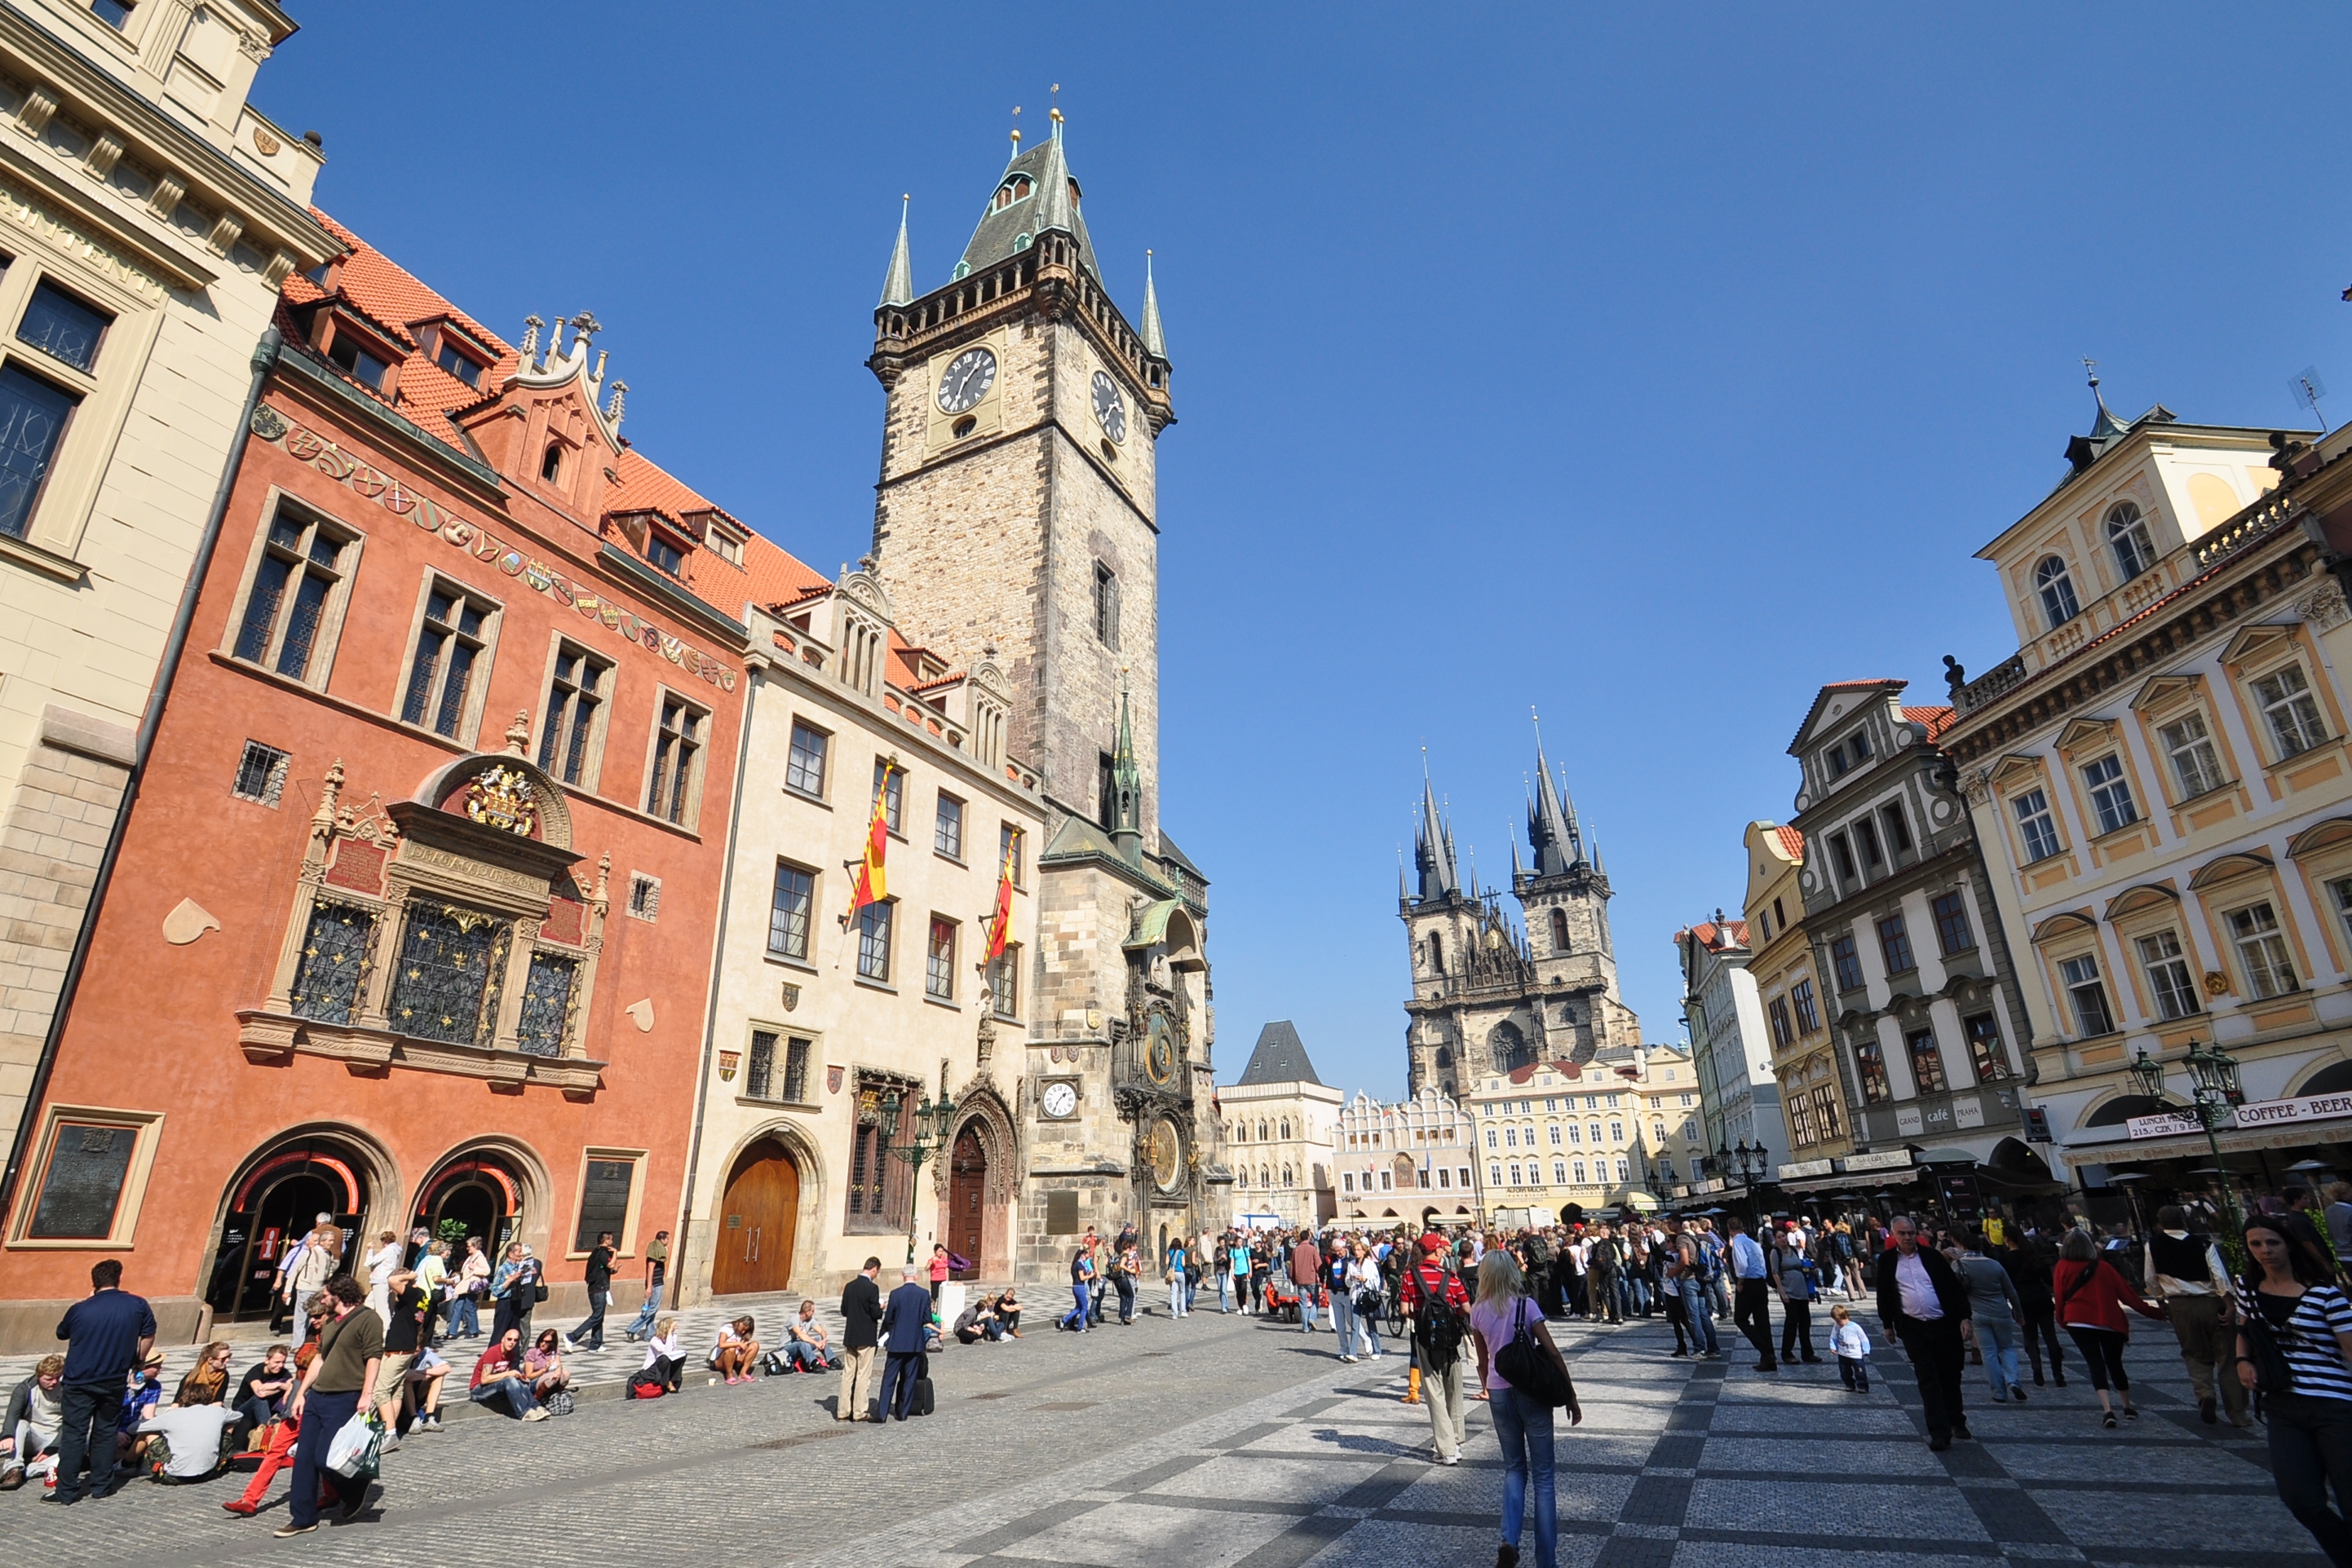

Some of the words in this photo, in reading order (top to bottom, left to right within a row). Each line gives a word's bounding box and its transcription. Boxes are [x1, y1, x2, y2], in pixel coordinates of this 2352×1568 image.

[1899, 1115, 1920, 1125] GRAND
[1927, 1109, 1949, 1122] café
[1957, 1107, 1978, 1117] PRAHA
[2238, 1104, 2297, 1123] COFFEE
[2309, 1098, 2352, 1115] BEER
[2138, 1115, 2166, 1125] LUNCH
[2155, 1125, 2172, 1133] CZK
[2179, 1123, 2186, 1131] 9
